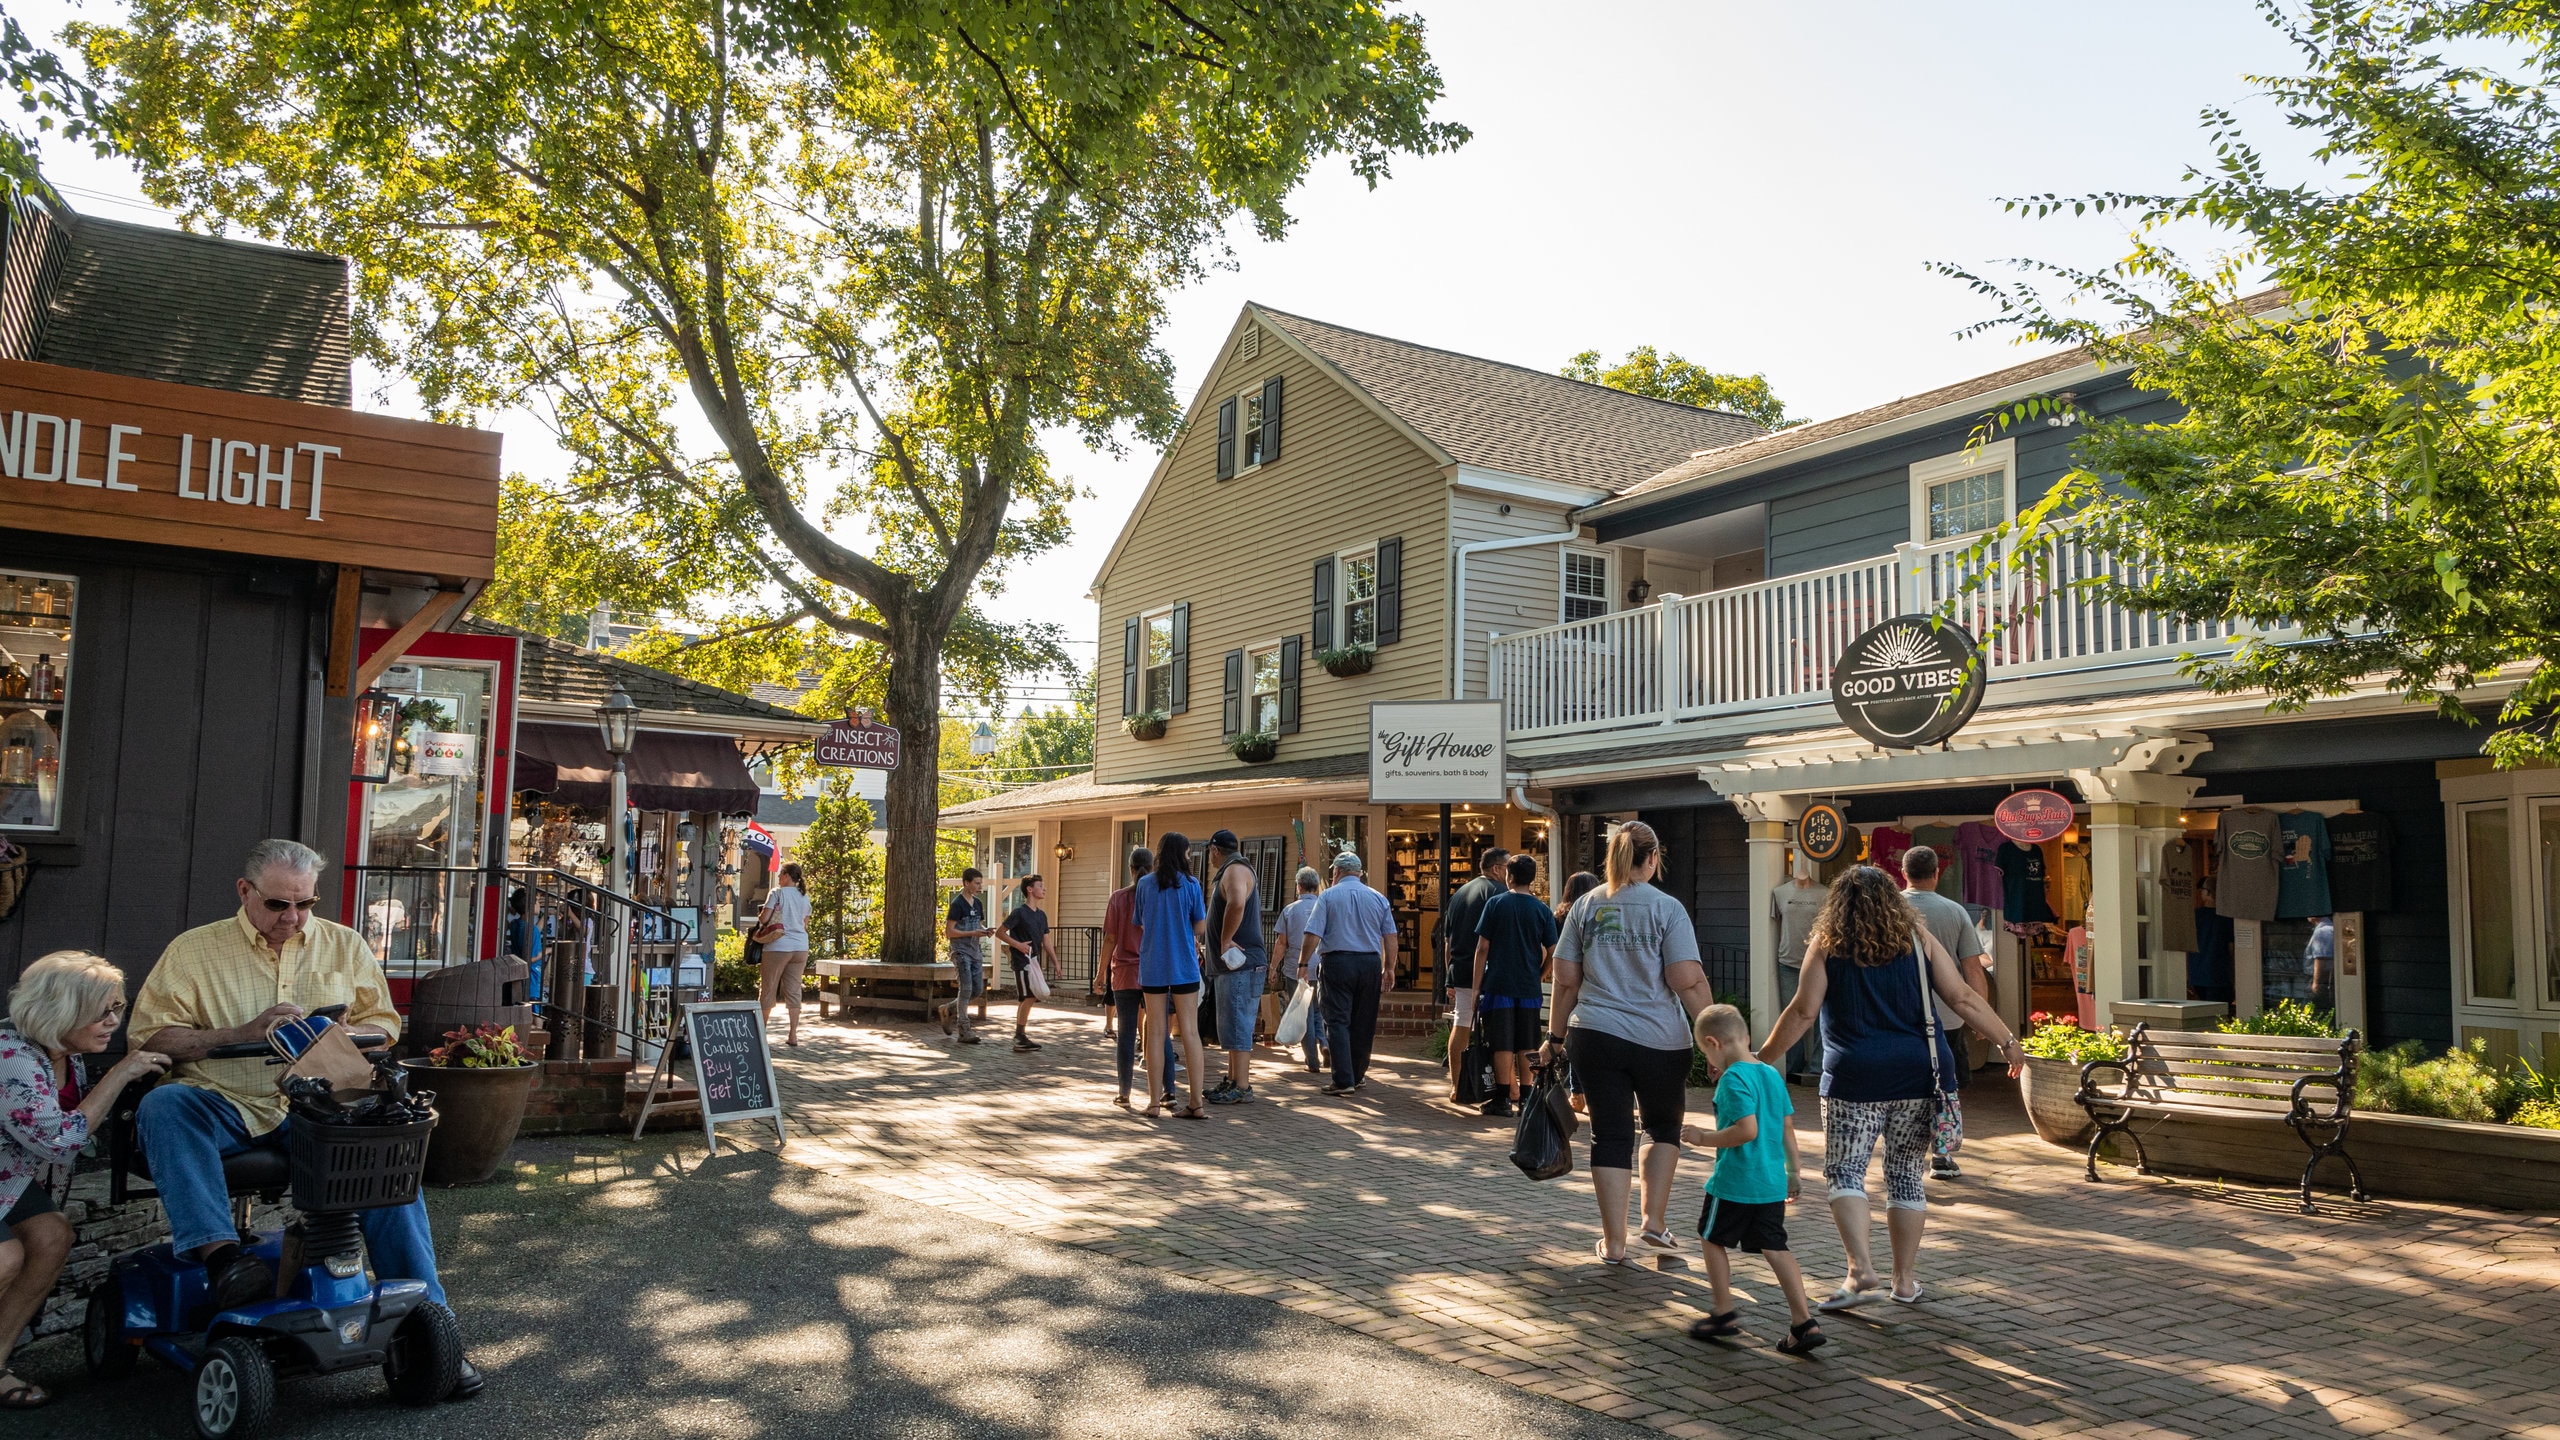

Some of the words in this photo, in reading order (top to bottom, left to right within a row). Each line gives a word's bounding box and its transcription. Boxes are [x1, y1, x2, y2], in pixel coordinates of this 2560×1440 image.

[179, 433, 342, 522] LIGHT
[1841, 676, 1896, 697] GOOD
[1901, 667, 1963, 690] VIBES
[834, 728, 883, 747] INSECT
[1378, 729, 1390, 739] the
[820, 746, 895, 765] CREATIONS
[1383, 731, 1427, 767] Gift
[1426, 732, 1496, 761] House
[1385, 769, 1404, 778] gifts,
[1405, 769, 1442, 777] souvenirs,
[1469, 769, 1489, 778] body
[1811, 813, 1830, 827] Life
[2000, 808, 2018, 823] Old
[2042, 806, 2068, 821] Rule
[1808, 831, 1834, 845] good.
[1597, 933, 1627, 943] GREEN
[1631, 934, 1659, 944] HOUSE
[698, 1014, 755, 1039] Barrick
[703, 1041, 750, 1057] Candles
[703, 1058, 733, 1080] Buy
[736, 1054, 749, 1074] 3
[708, 1079, 732, 1100] Get
[736, 1072, 761, 1099] 15%
[747, 1093, 763, 1108] off
